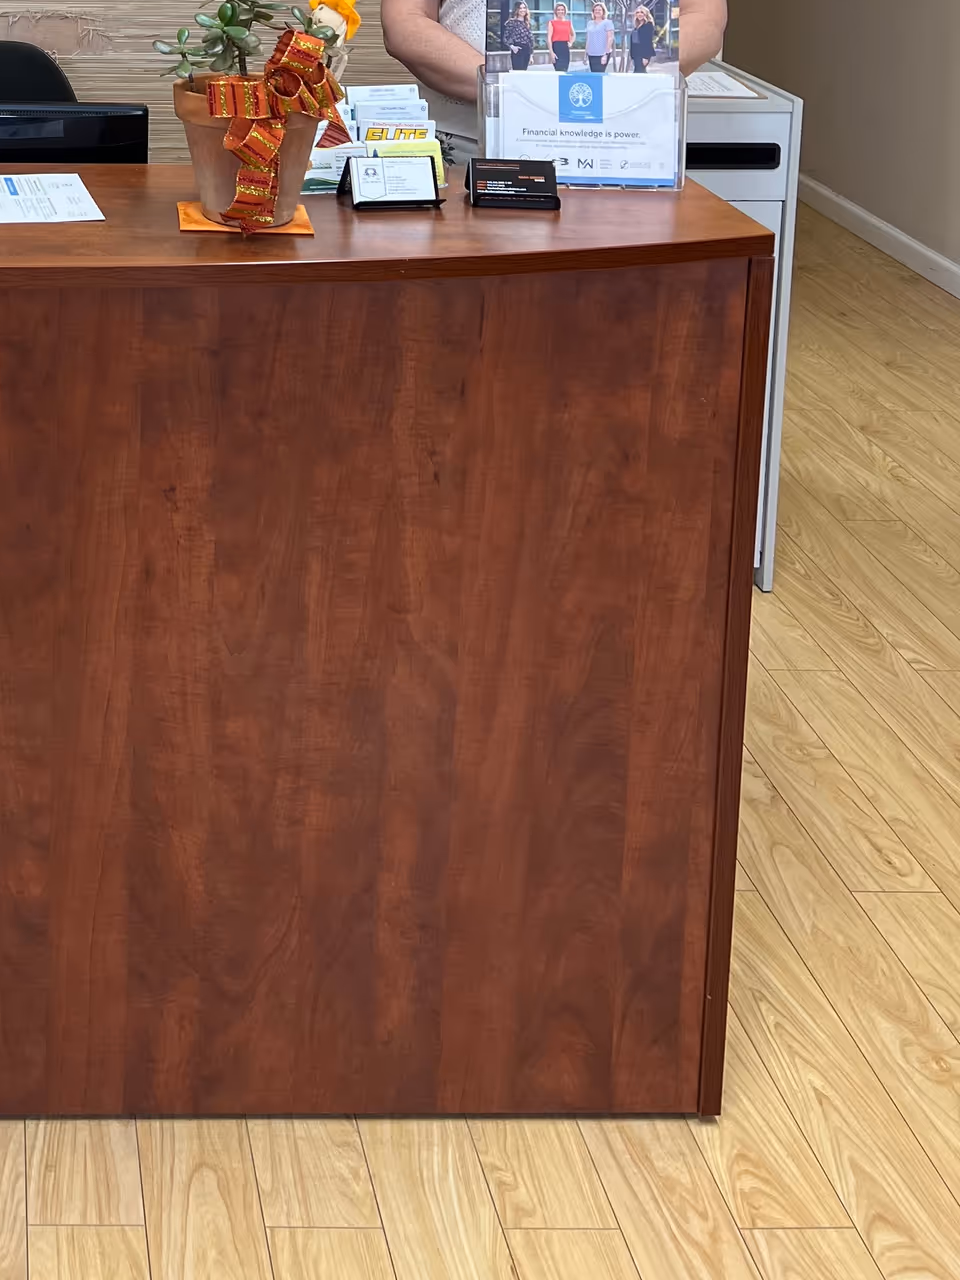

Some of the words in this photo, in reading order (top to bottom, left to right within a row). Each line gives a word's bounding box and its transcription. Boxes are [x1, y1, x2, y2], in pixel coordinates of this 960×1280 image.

[365, 128, 428, 140] ELITE
[523, 128, 557, 136] Financial
[560, 129, 603, 138] knowledge
